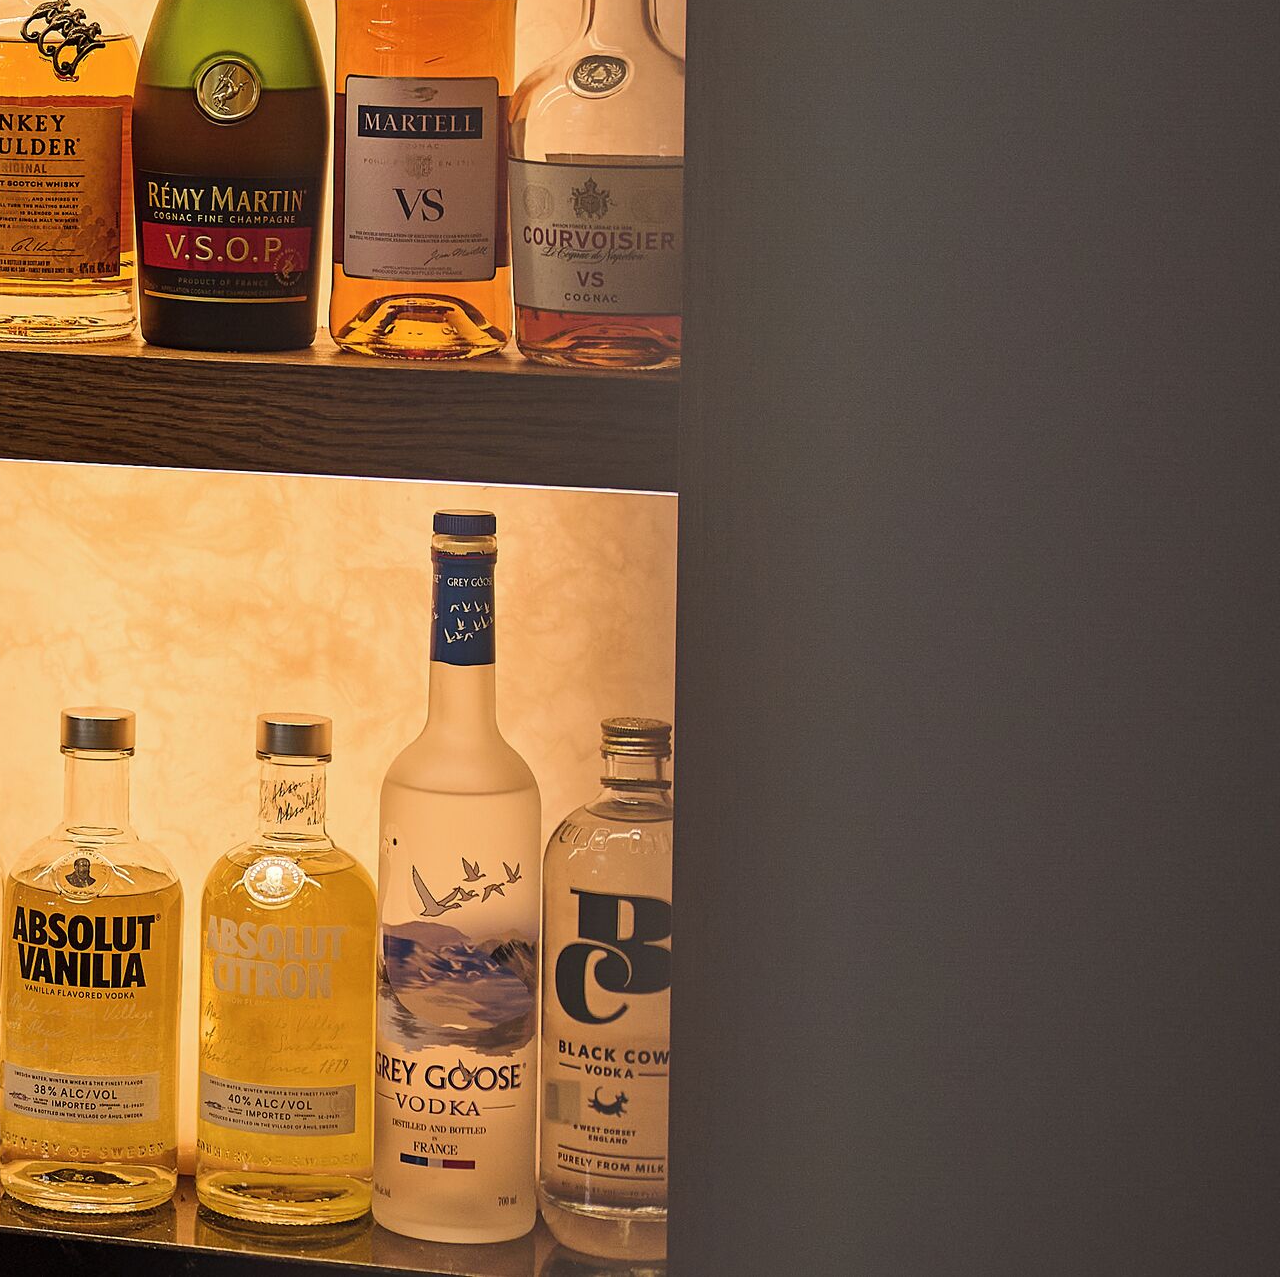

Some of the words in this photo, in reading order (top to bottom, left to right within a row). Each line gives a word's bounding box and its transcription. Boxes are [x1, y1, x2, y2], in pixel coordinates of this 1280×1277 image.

[363, 111, 476, 133] MARTELL
[147, 176, 205, 213] RÉMY
[210, 185, 304, 213] MARTIN
[391, 187, 446, 223] VS
[153, 211, 193, 223] COGNAC
[197, 213, 224, 224] FINE
[229, 214, 296, 224] CHAMPAGNE
[523, 225, 677, 251] COURVOISIER
[576, 270, 605, 288] VS
[563, 292, 619, 304] COGNAC
[12, 904, 156, 953] ABSOLUT
[206, 914, 348, 963] ABSOLUT
[17, 942, 147, 989] VANILIA
[212, 955, 333, 1000] CITRON
[24, 983, 55, 996] VANILLA
[57, 988, 103, 1000] FLAVORED
[104, 991, 135, 1000] VODKA
[558, 1039, 616, 1063] BLACK
[624, 1050, 670, 1065] COW
[375, 1051, 418, 1086] GREY
[424, 1063, 523, 1091] GOOSE
[584, 1064, 634, 1079] VODKA
[33, 1084, 57, 1097] 38%
[60, 1087, 118, 1100] ALC/VOL
[228, 1093, 251, 1107] 40%
[255, 1098, 313, 1111] ALC/VOL
[51, 1099, 97, 1110] IMPORTED
[394, 1092, 481, 1117] VODKA
[245, 1110, 291, 1121] IMPORTED
[392, 1118, 427, 1132] DISTILLED
[429, 1124, 447, 1134] AND
[449, 1126, 487, 1135] BOTTLED
[413, 1141, 458, 1156] FRANCE
[588, 1134, 629, 1145] ENGLAND
[557, 1152, 592, 1168] PURELY
[596, 1160, 630, 1173] FROM
[635, 1164, 665, 1174] MILK
